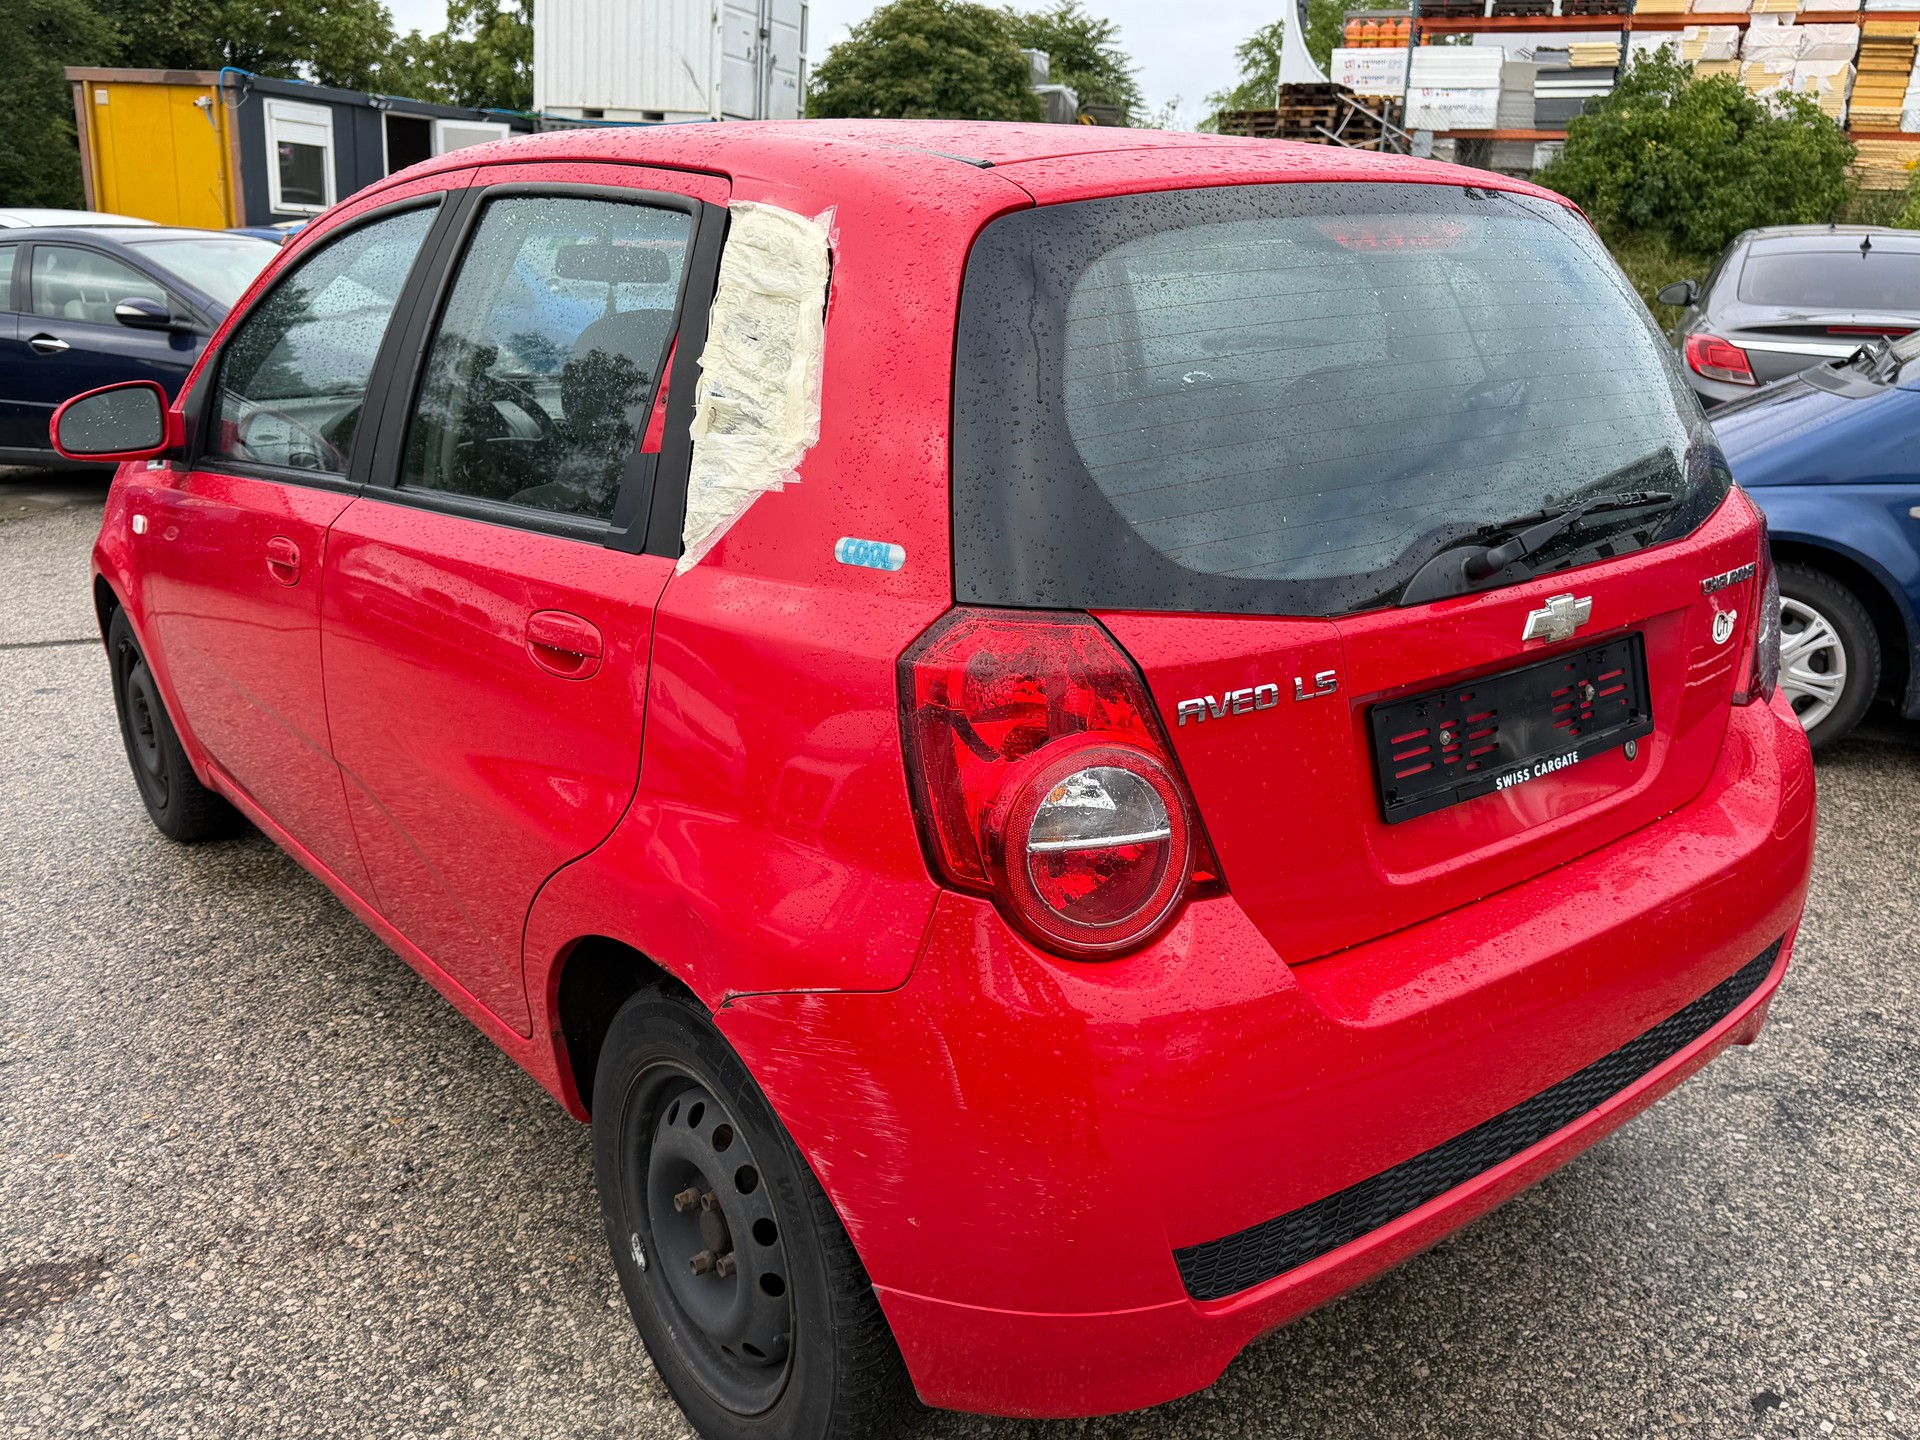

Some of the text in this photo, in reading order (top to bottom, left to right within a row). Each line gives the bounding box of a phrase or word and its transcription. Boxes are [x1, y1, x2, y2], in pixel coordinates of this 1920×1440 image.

[842, 538, 894, 570] COOL
[1716, 614, 1729, 637] CH
[1177, 669, 1338, 726] AVEO LS
[1496, 751, 1579, 790] SWISS CARGATE
